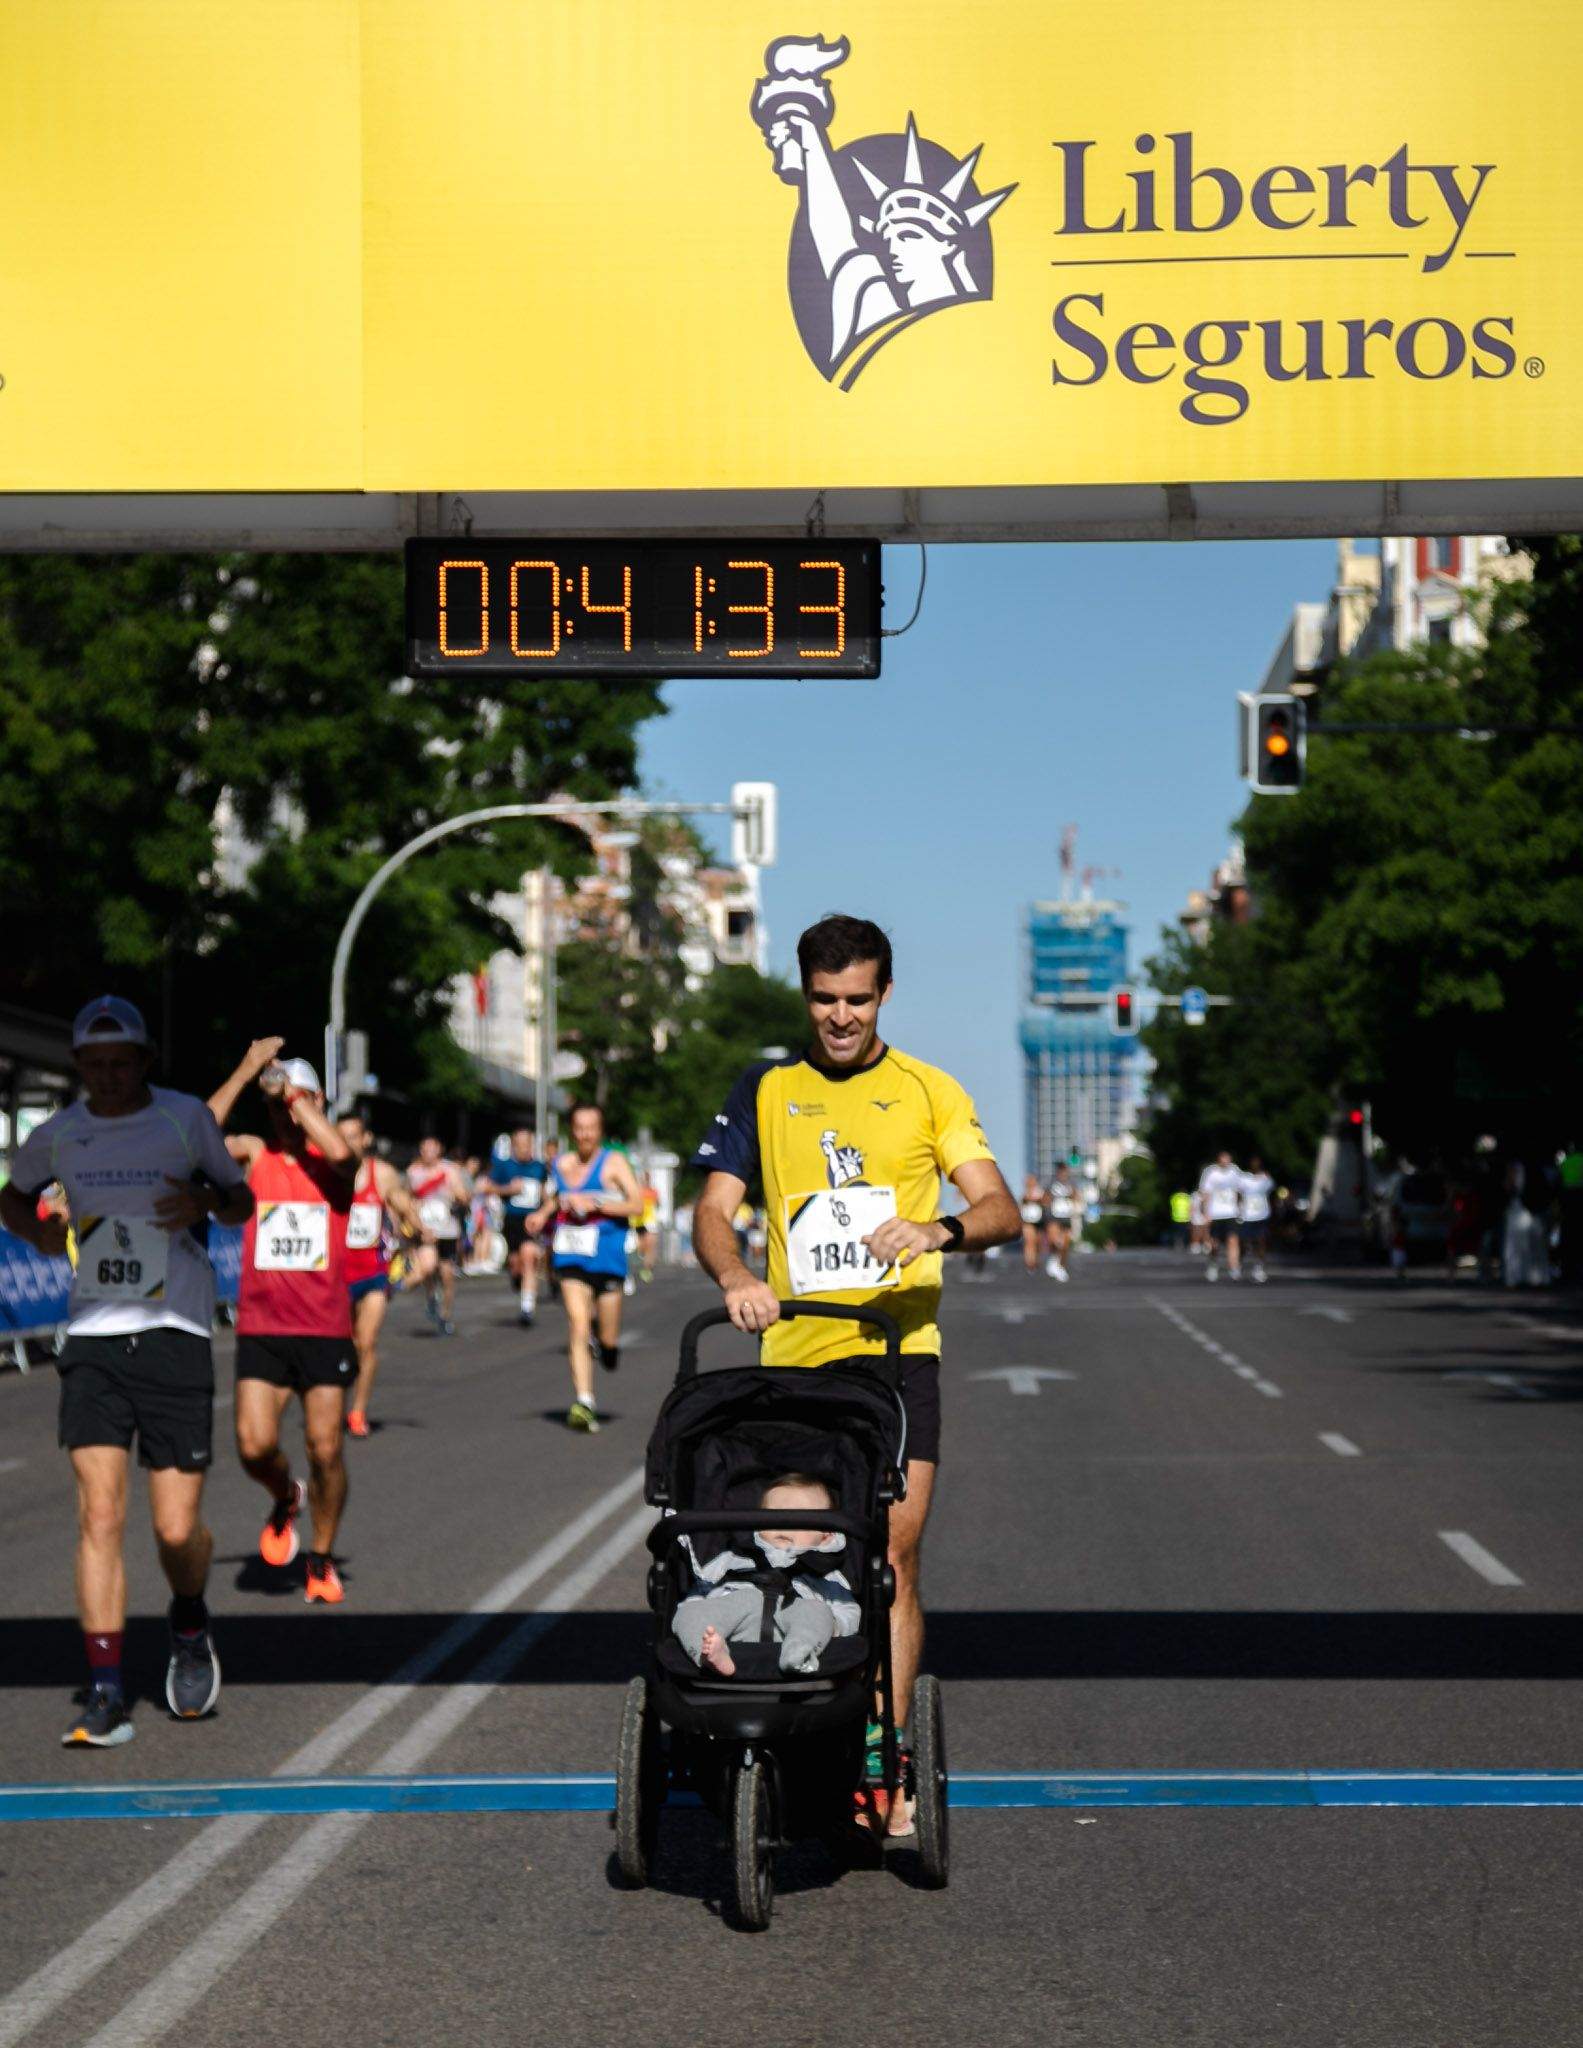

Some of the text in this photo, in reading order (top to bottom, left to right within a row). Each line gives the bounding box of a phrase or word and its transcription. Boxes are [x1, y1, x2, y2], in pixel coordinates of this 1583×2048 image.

[1052, 131, 1497, 272] Liberty
[1052, 293, 1516, 425] Seguros
[97, 1258, 142, 1285] 639
[270, 1236, 313, 1258] 3377
